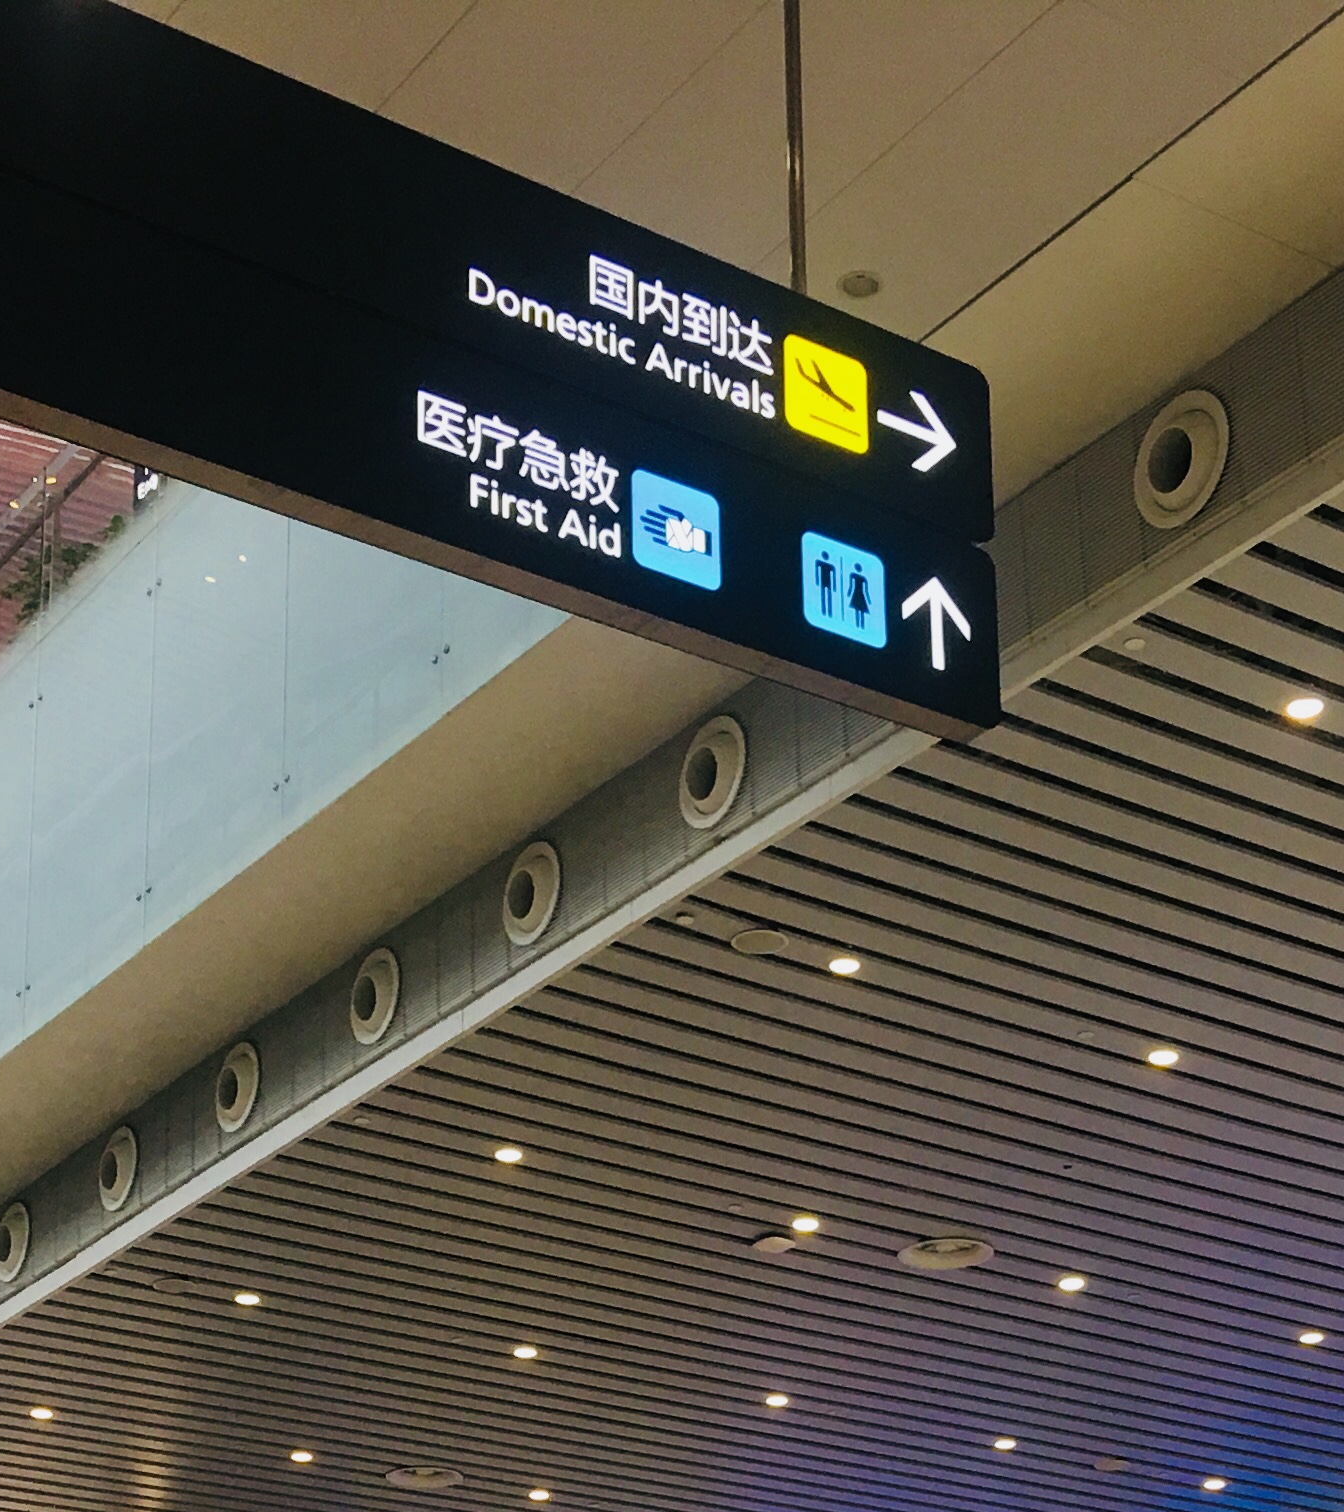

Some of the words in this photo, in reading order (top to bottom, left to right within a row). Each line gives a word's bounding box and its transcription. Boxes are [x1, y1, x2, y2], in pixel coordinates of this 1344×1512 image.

[468, 268, 636, 365] Domestic
[644, 343, 776, 420] Arrivals
[589, 254, 774, 376] 国内到达
[416, 388, 620, 514] 医疗急救
[468, 474, 548, 533] First
[558, 502, 622, 559] Aid
